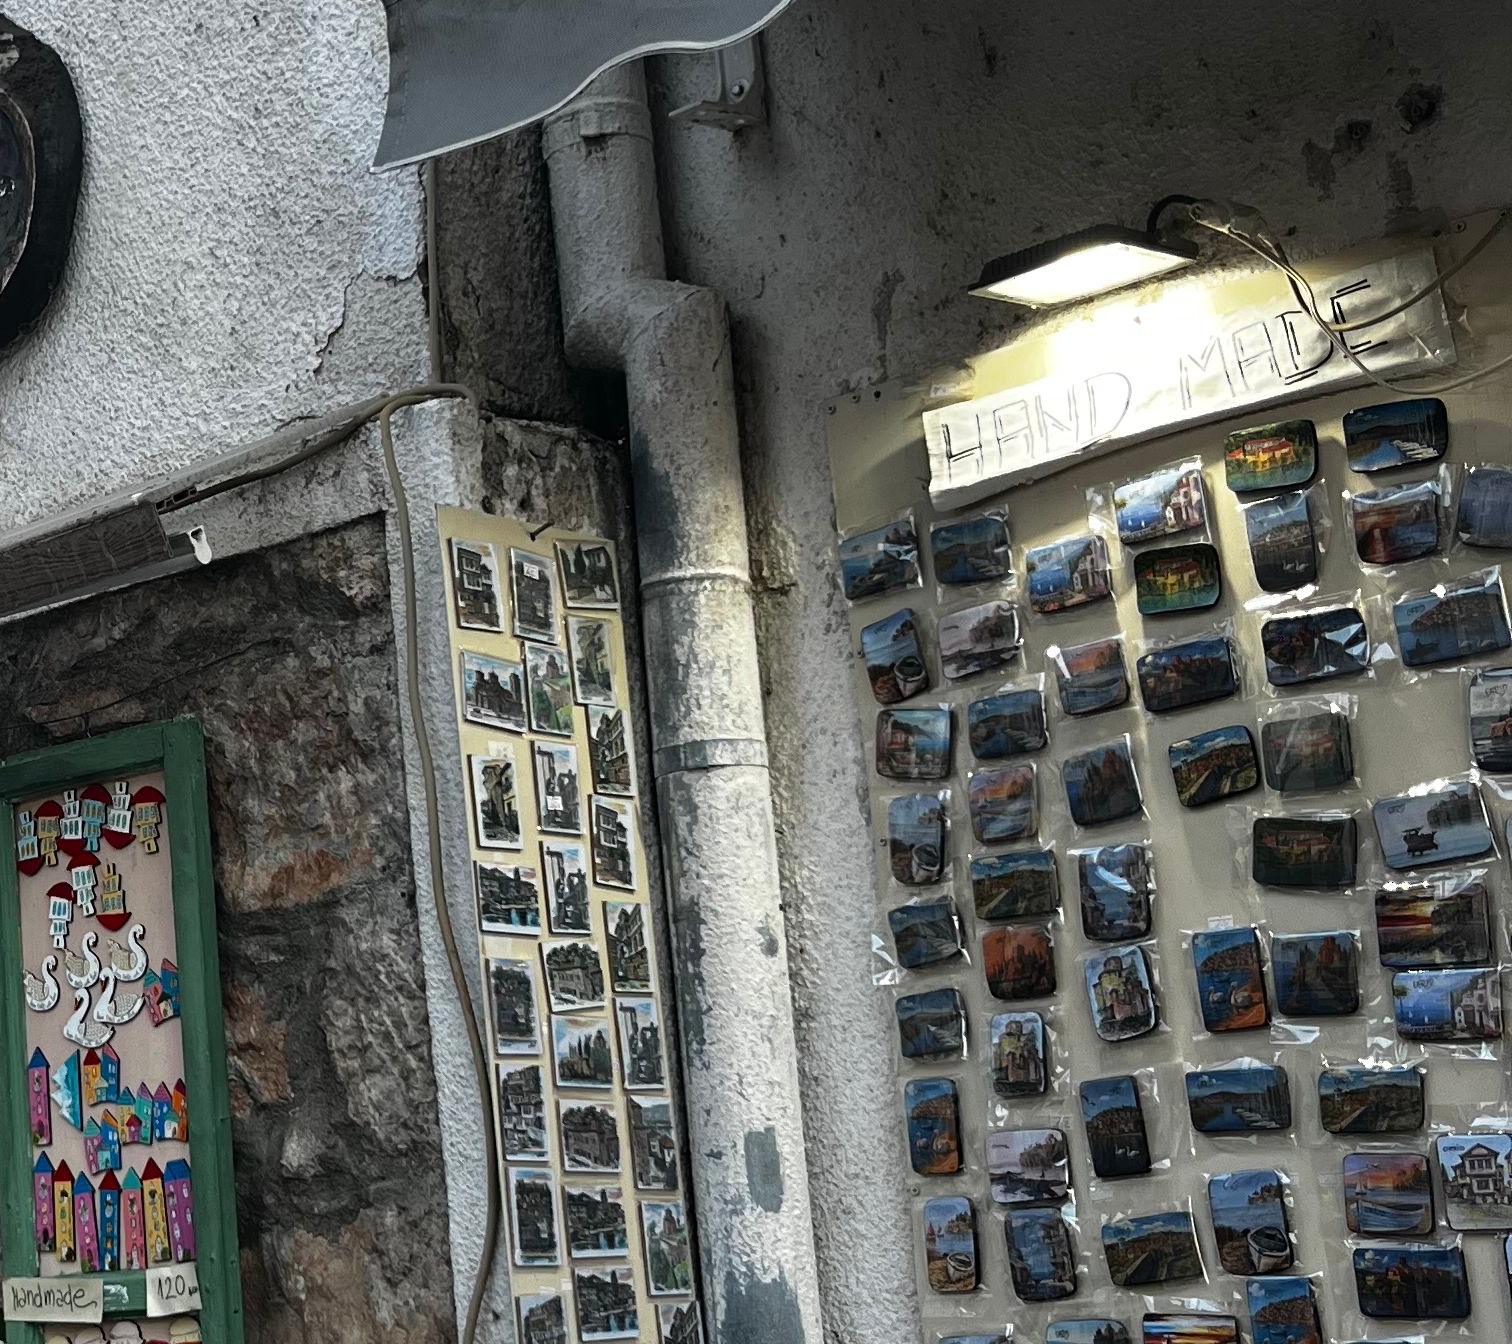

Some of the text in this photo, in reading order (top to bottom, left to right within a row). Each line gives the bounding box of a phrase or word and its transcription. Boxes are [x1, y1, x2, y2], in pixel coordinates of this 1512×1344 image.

[941, 279, 1389, 485] HAND MADE
[11, 1283, 98, 1312] Handmade
[158, 1274, 185, 1300] 120
